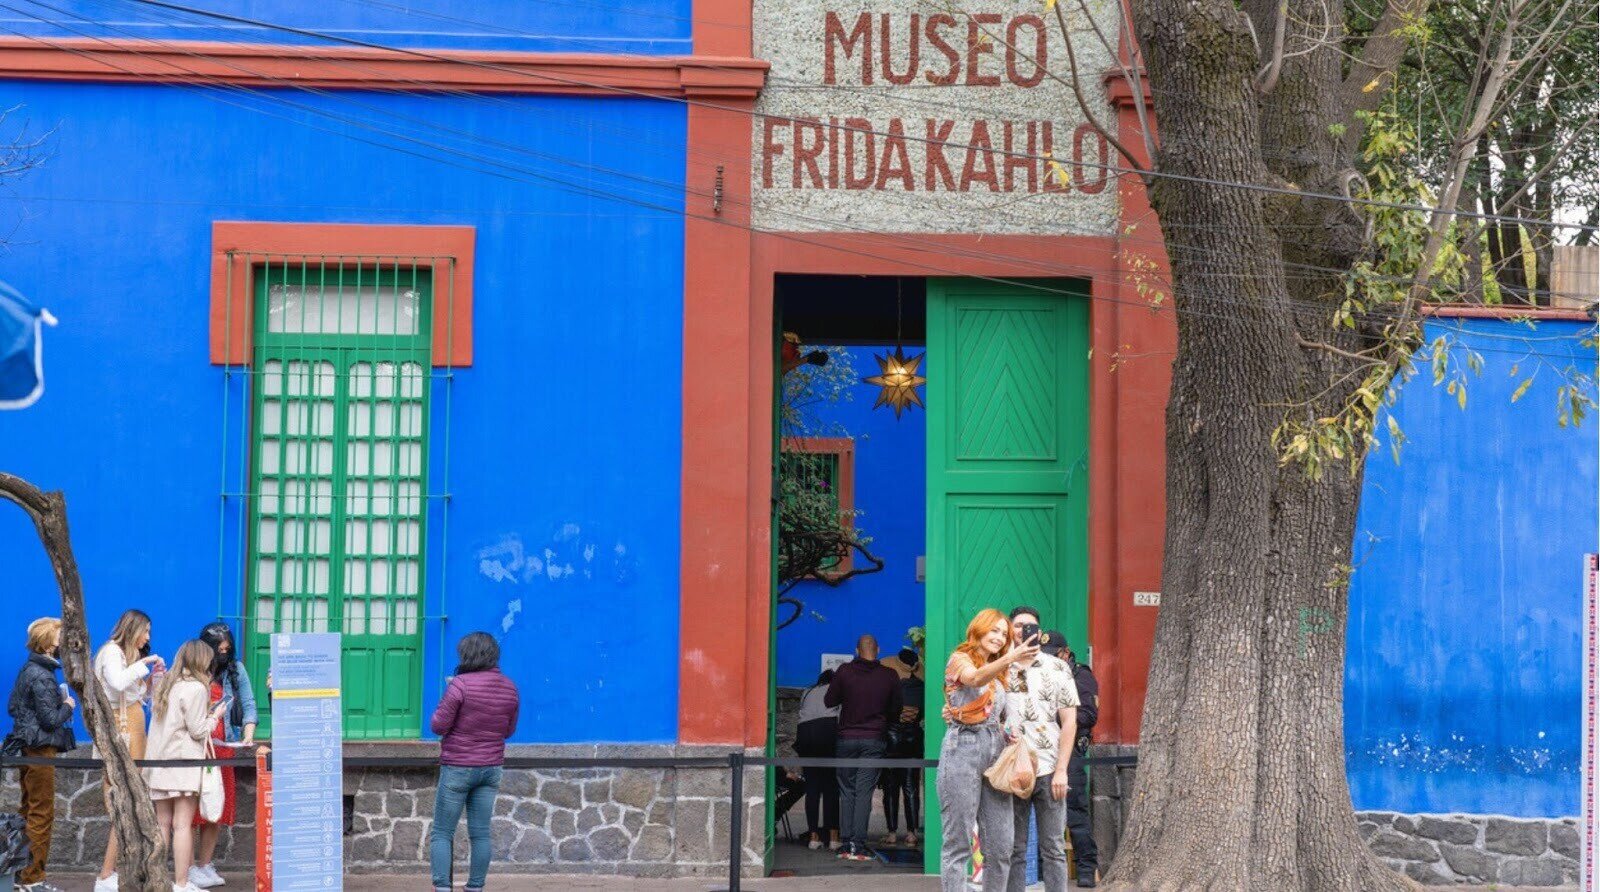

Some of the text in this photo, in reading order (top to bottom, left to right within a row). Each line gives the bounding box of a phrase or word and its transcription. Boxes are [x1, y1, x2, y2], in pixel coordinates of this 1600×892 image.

[824, 11, 1047, 88] MUSEO
[762, 116, 1108, 194] FRIDA KAHLO
[1137, 594, 1159, 604] 247
[265, 809, 273, 879] INTERNET
